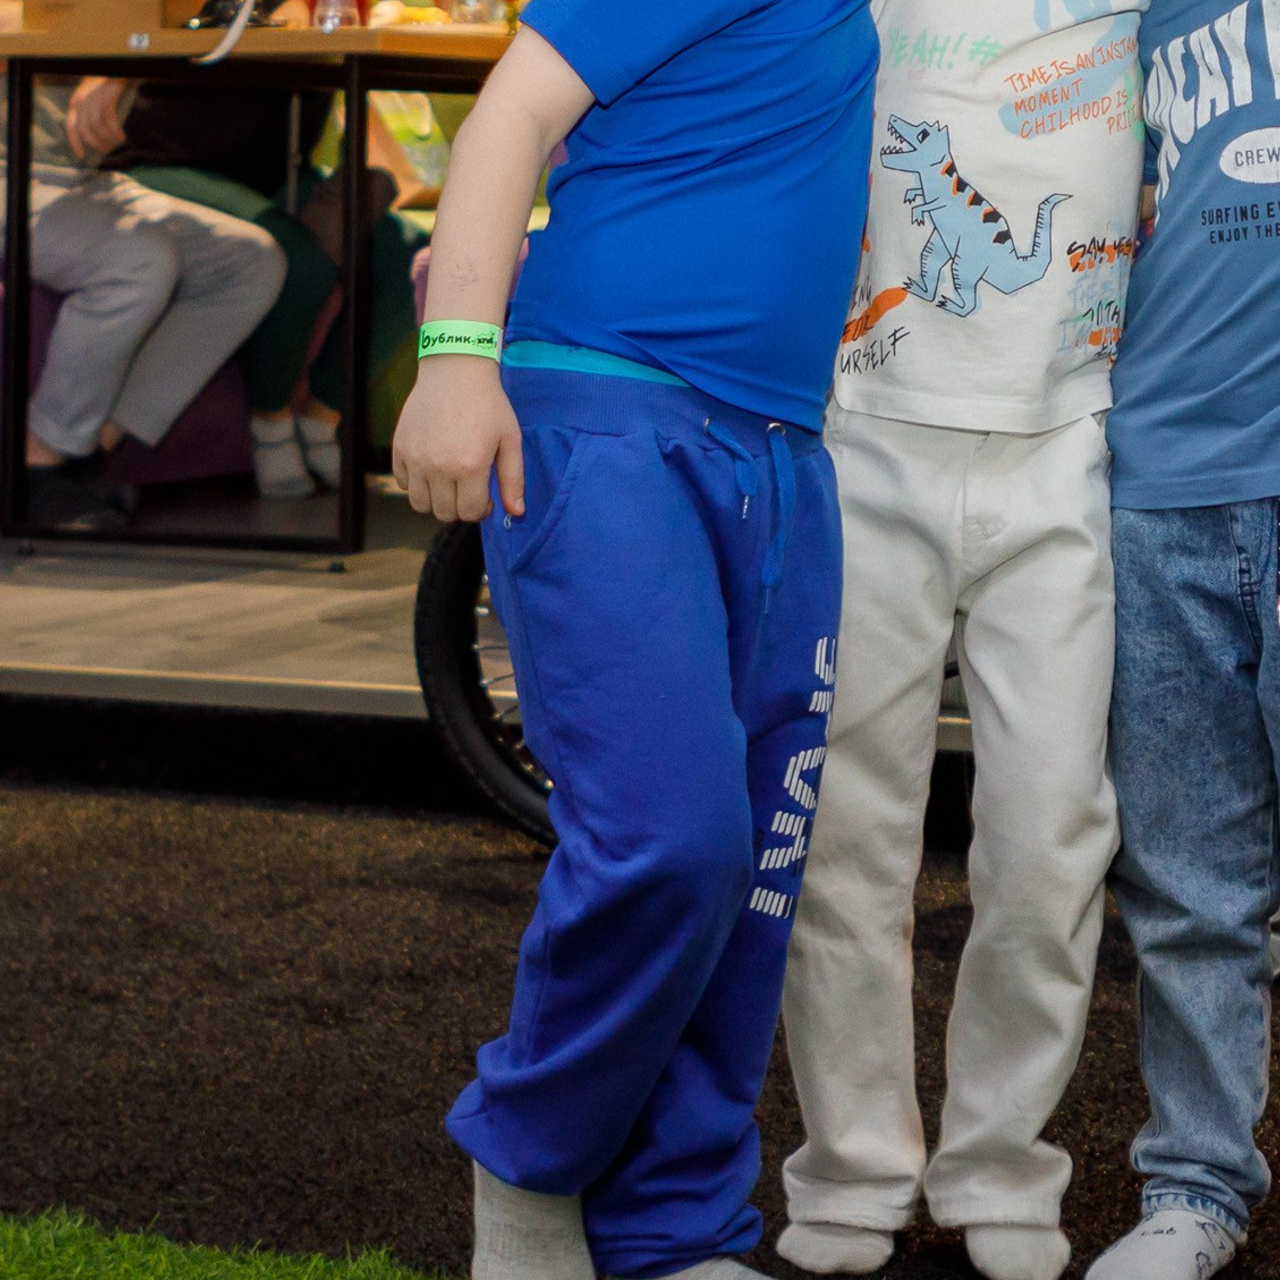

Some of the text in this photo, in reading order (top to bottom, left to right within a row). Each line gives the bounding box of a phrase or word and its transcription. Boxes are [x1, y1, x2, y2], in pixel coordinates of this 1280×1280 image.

[1014, 77, 1083, 116] MOMENT
[1234, 146, 1280, 167] CREW
[1201, 203, 1260, 226] SURFING
[1209, 227, 1249, 244] ENJOY
[841, 326, 912, 375] URSELF
